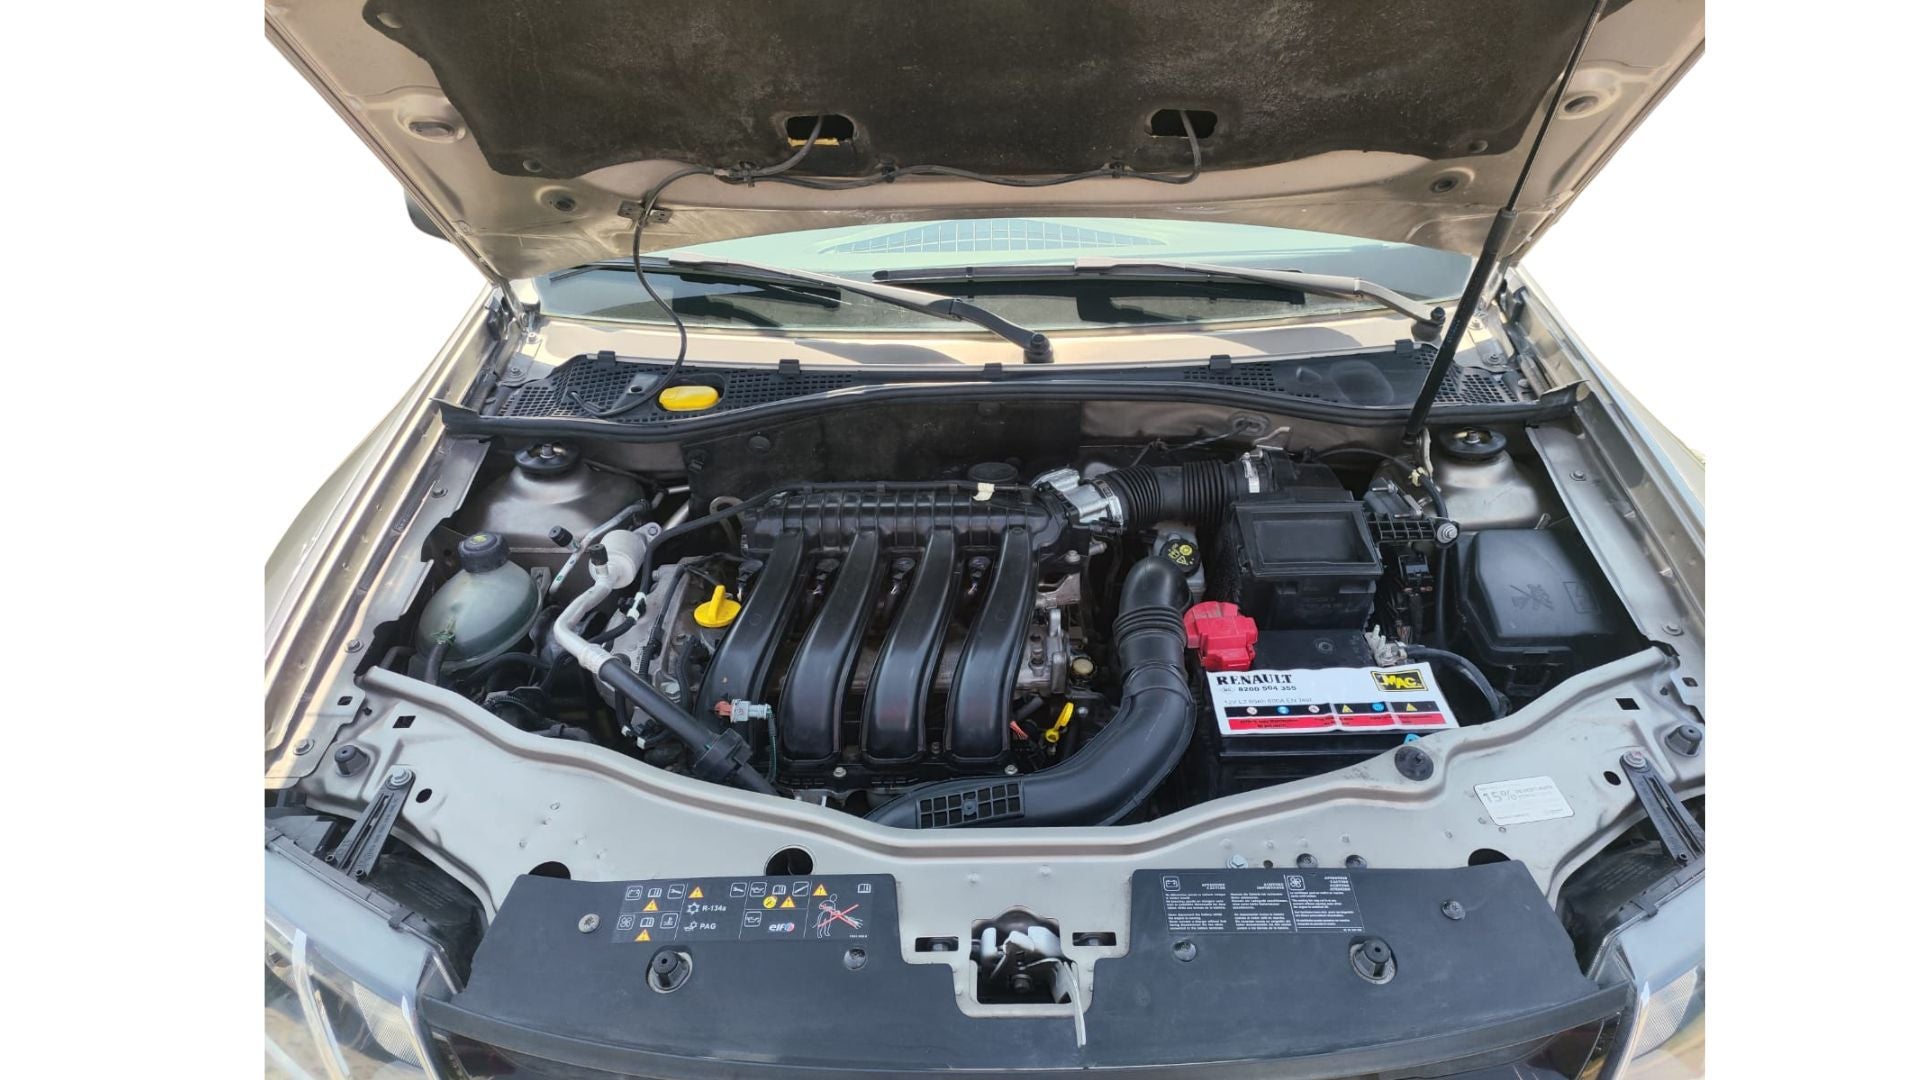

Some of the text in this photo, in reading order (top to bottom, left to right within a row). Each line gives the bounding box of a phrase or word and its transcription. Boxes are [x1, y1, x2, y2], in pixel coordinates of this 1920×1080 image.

[1215, 673, 1292, 686] RENAULT
[1483, 790, 1517, 803] 15%
[702, 904, 727, 912] R-134a
[699, 922, 717, 931] PAG
[768, 922, 788, 932] elf
